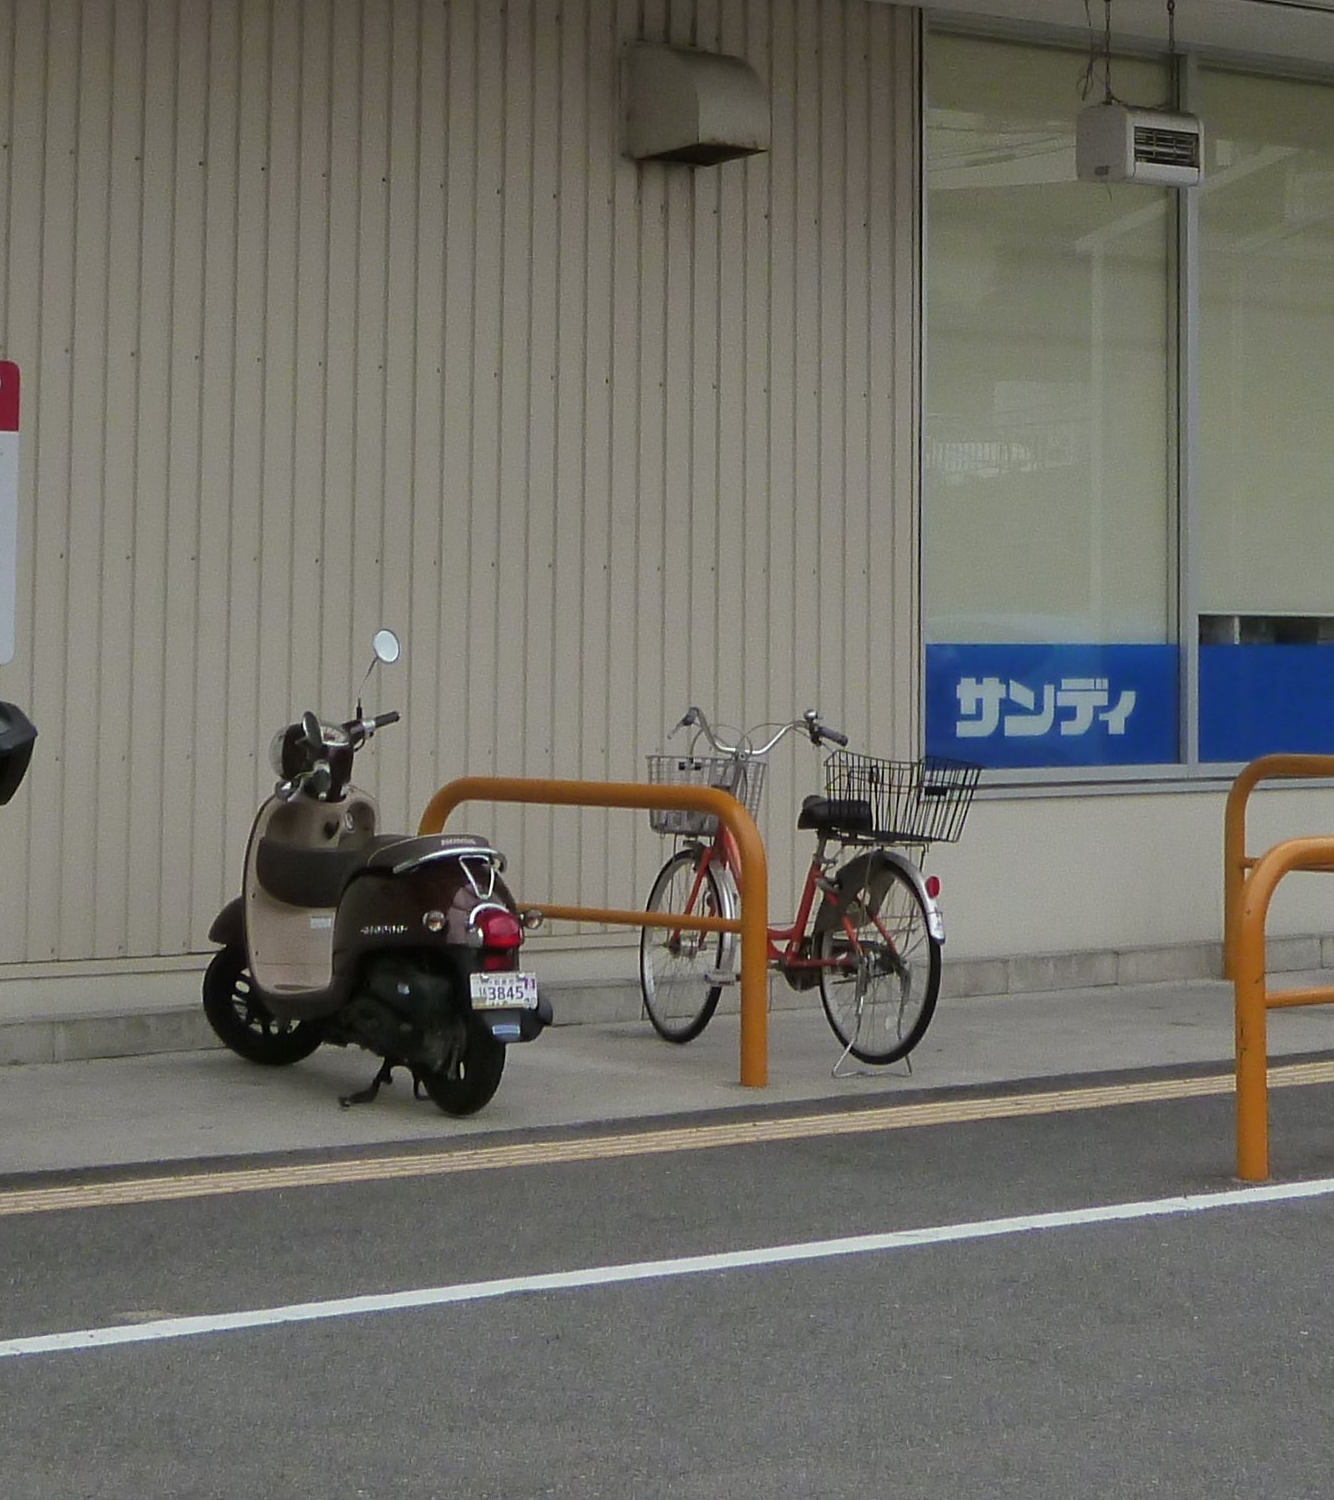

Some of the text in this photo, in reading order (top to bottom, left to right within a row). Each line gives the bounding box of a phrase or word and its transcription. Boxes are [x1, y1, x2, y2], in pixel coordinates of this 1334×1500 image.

[955, 677, 1137, 738] サンディ
[487, 986, 524, 1001] 3845
